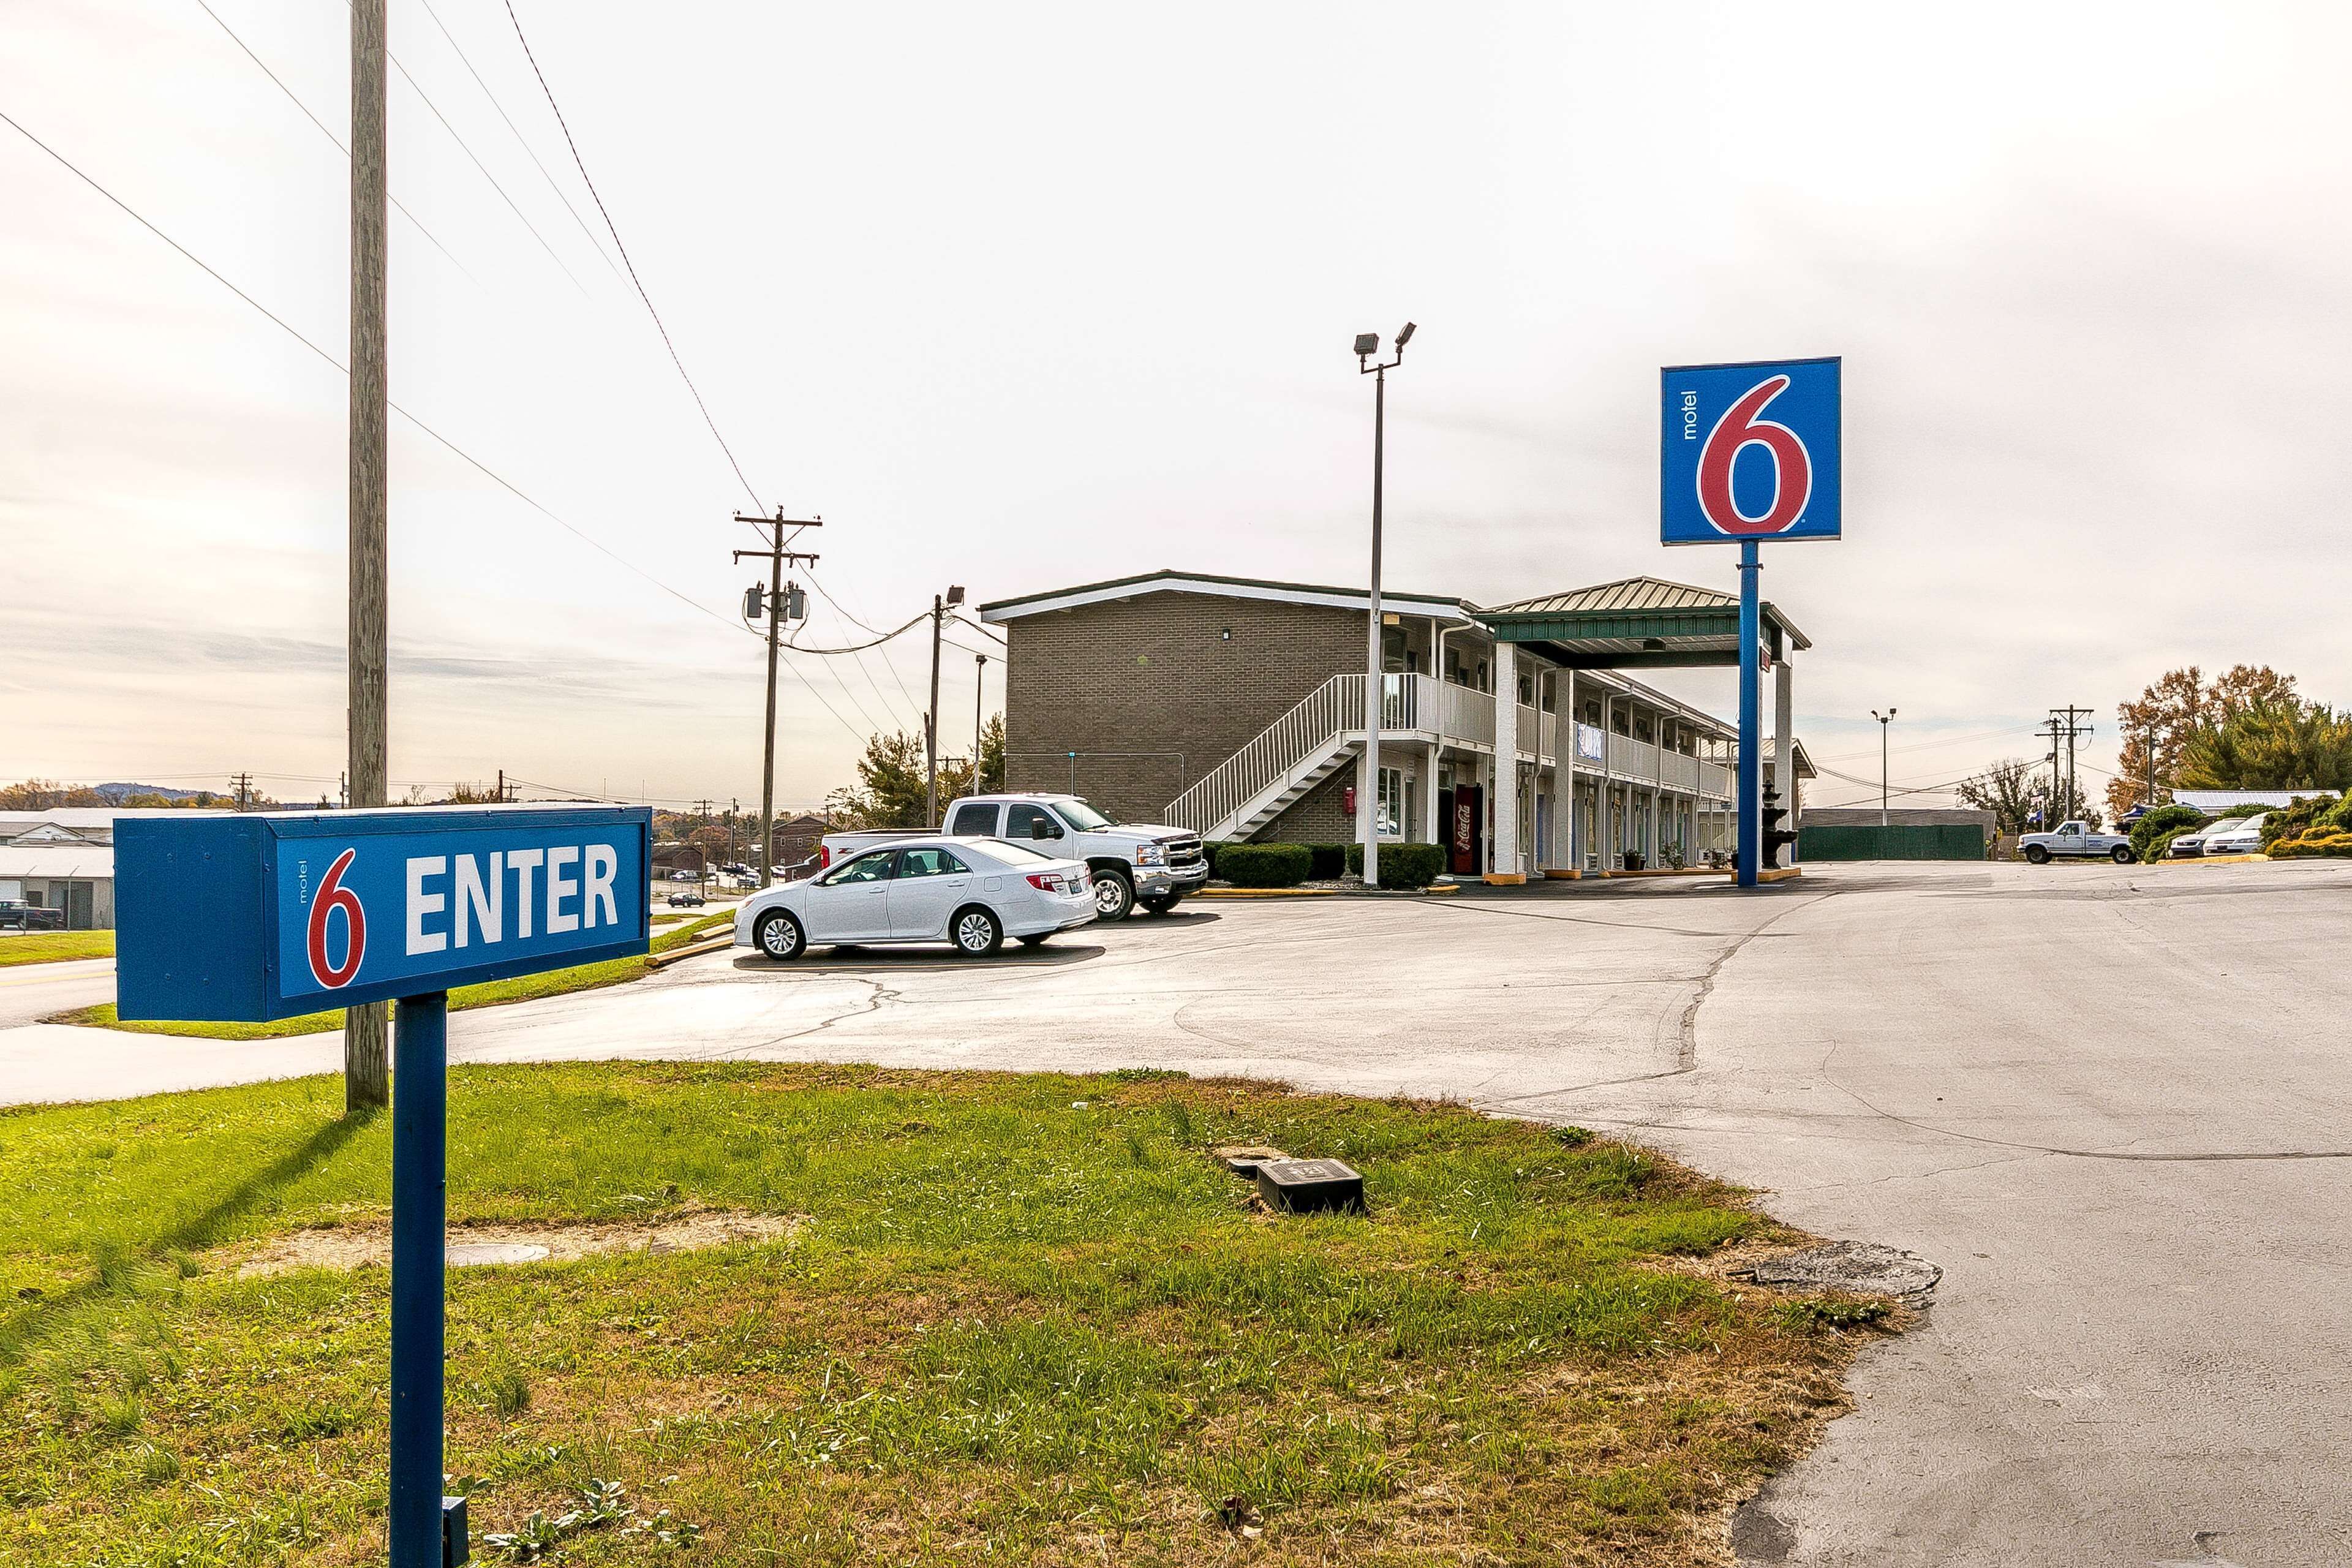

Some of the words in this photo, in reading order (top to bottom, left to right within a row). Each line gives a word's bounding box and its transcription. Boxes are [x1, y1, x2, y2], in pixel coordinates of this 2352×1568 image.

[1680, 391, 1697, 440] motel
[1695, 374, 1812, 535] 6
[298, 860, 307, 904] motel
[307, 847, 366, 990] 6
[406, 843, 618, 956] ENTER
